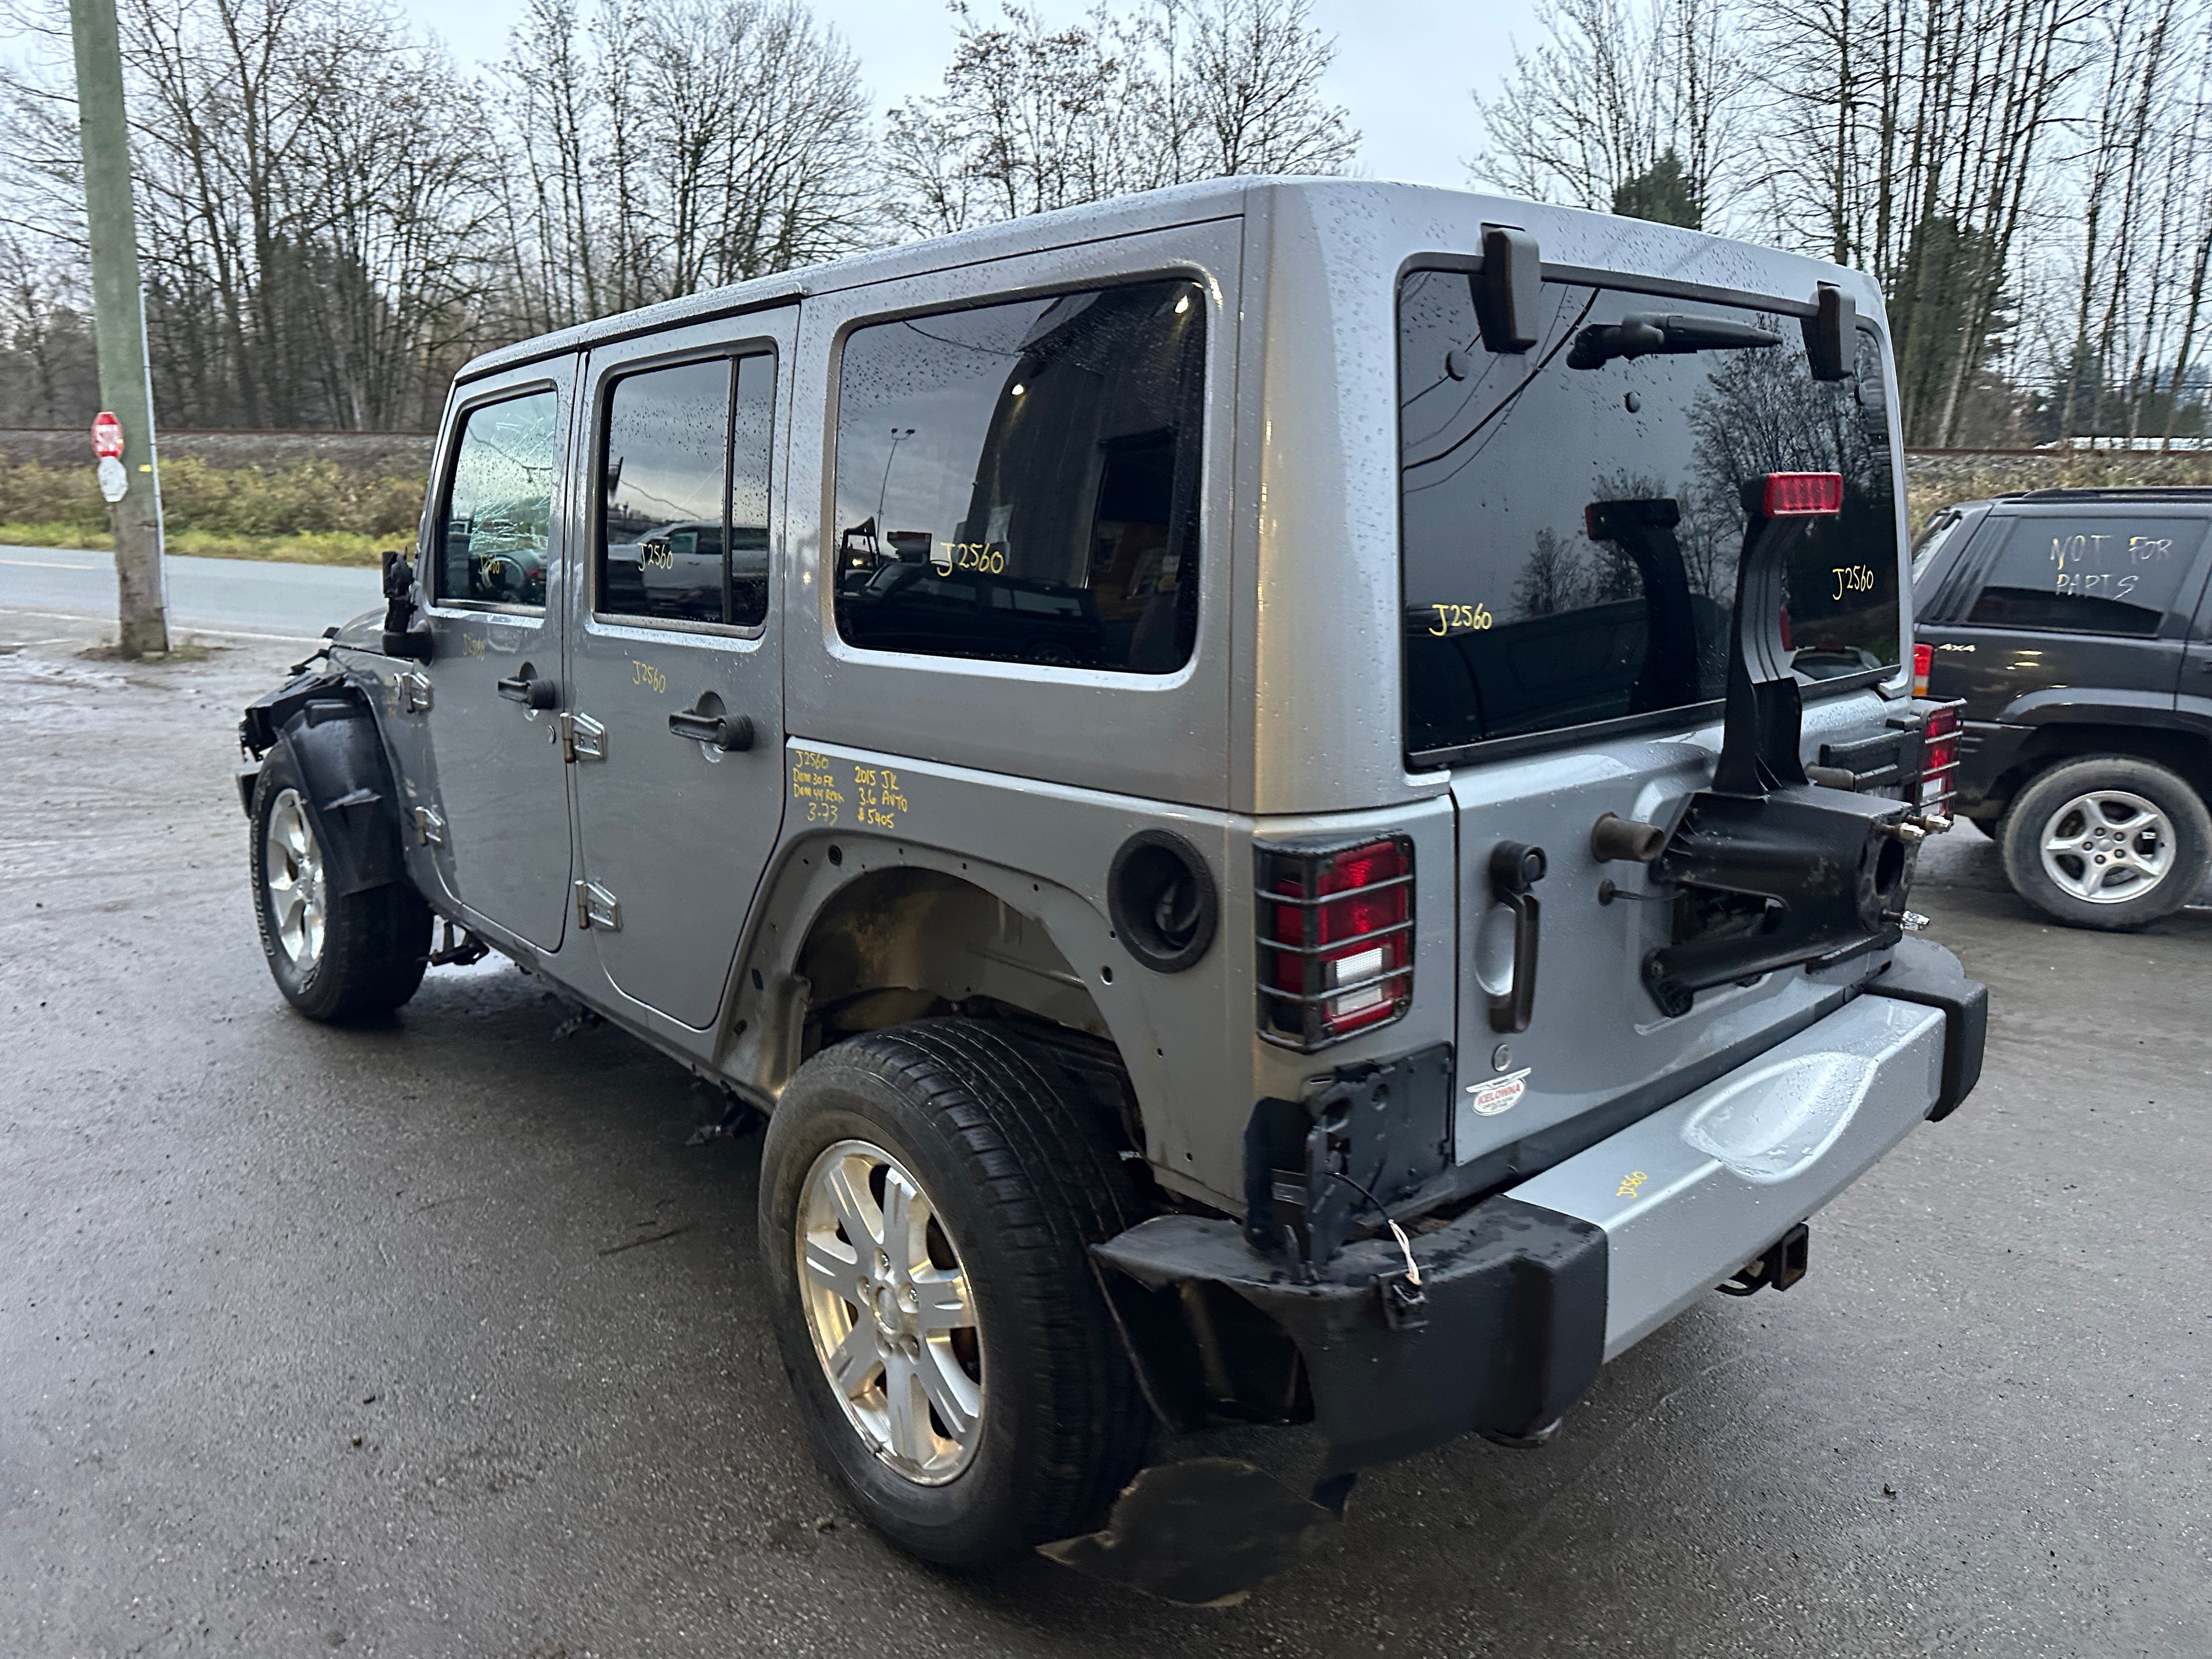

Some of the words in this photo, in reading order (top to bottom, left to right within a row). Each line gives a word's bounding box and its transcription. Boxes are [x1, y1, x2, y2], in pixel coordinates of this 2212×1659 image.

[637, 542, 673, 571] J2560
[937, 541, 1005, 577] J2560
[2050, 535, 2112, 570] NOT
[2128, 536, 2173, 564] FOR
[1832, 564, 1874, 600] J2560
[1429, 603, 1493, 636] J2560
[632, 660, 666, 694] J2560
[795, 750, 830, 770] J2560
[854, 766, 876, 786] 2015
[858, 787, 876, 806] 3.6
